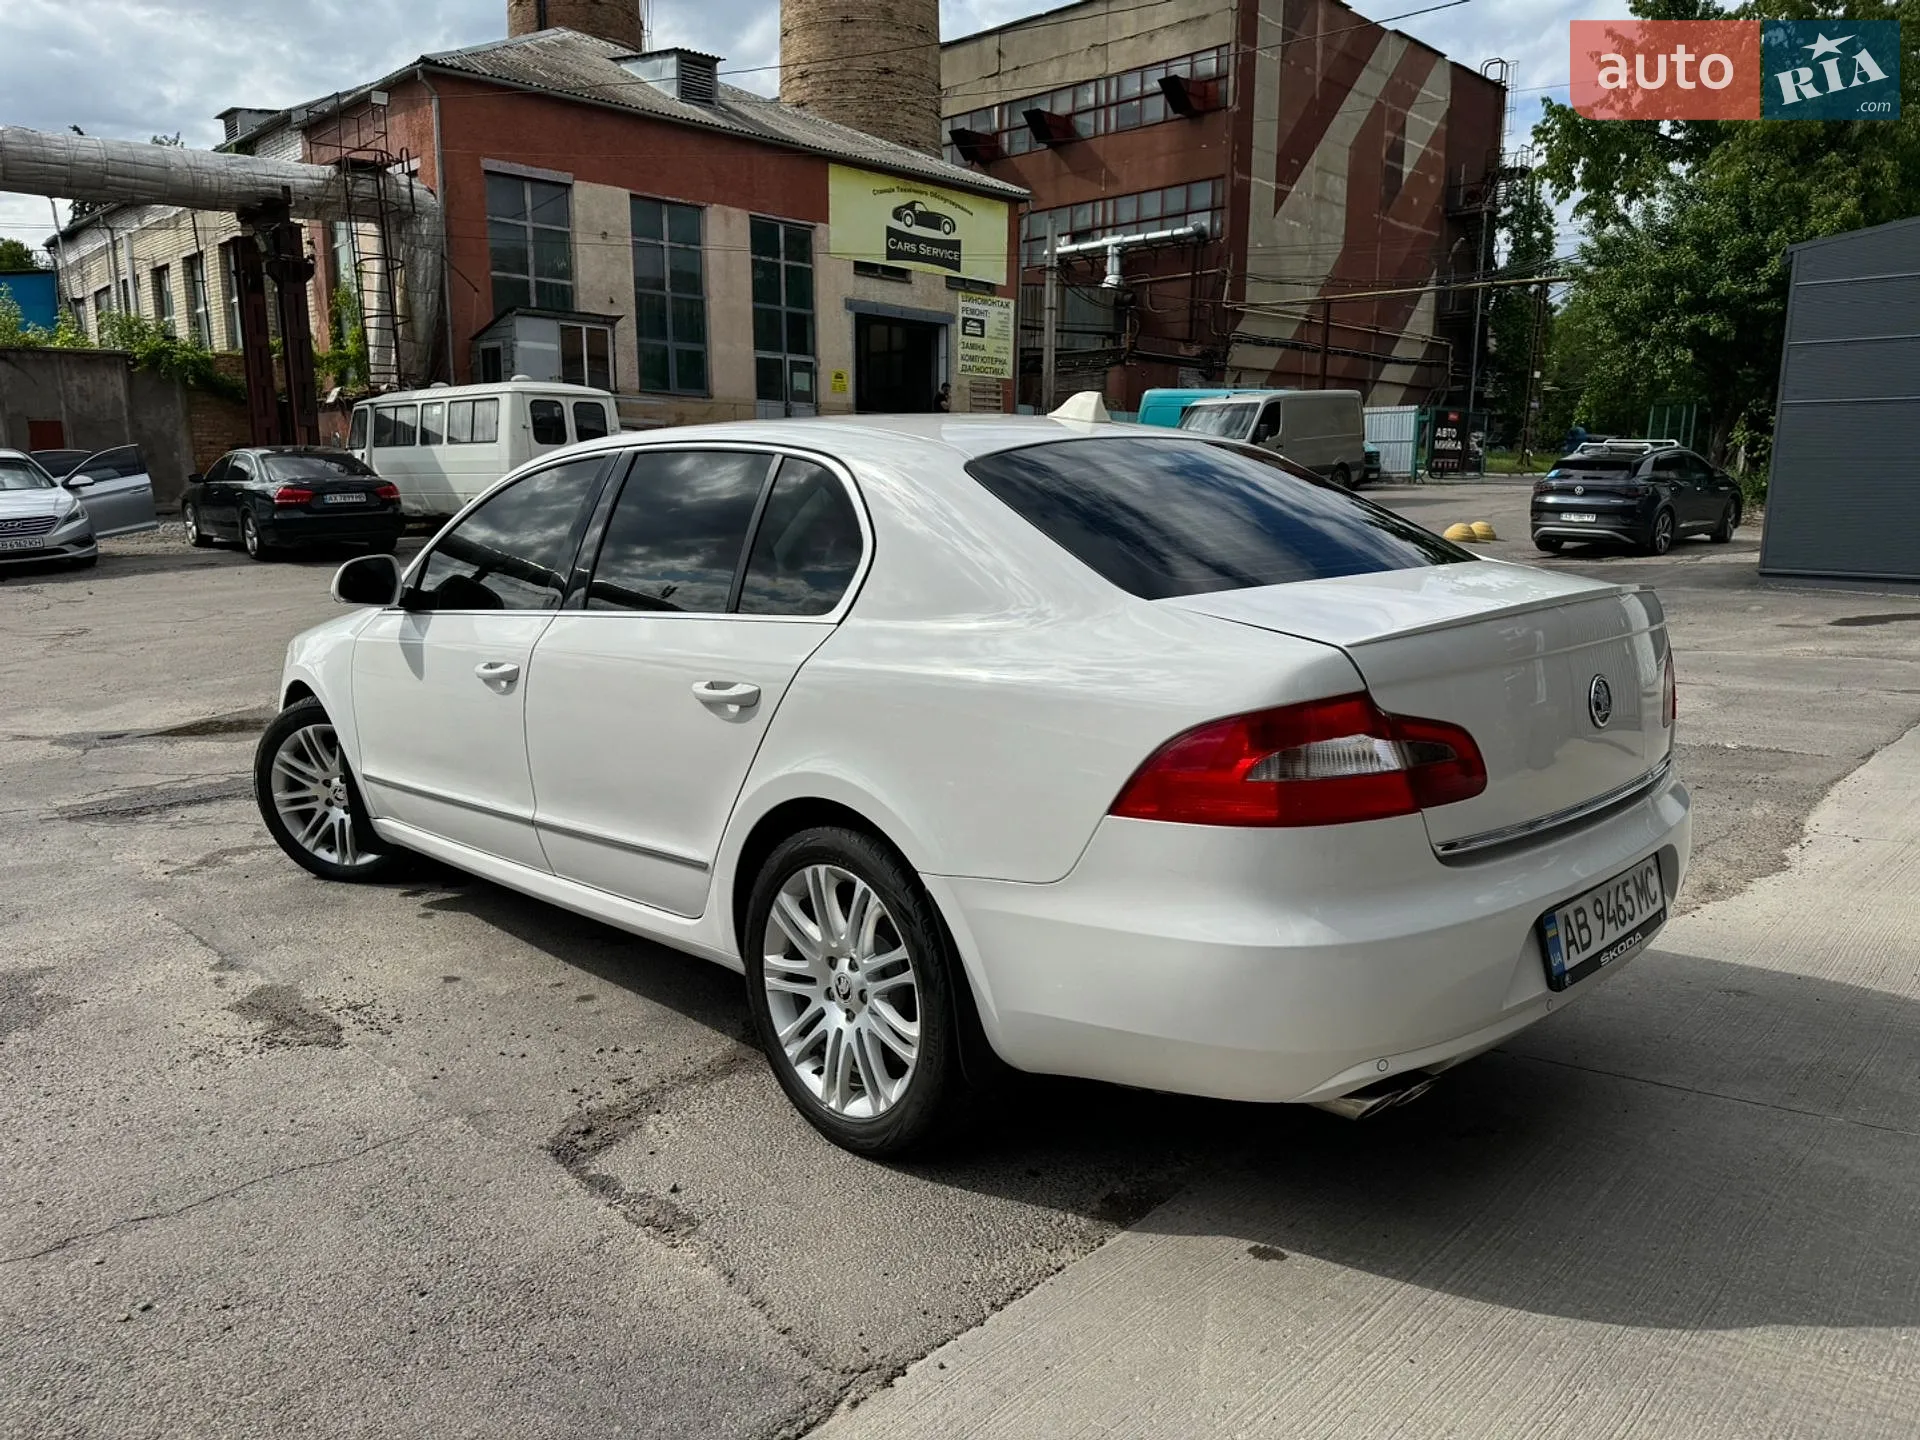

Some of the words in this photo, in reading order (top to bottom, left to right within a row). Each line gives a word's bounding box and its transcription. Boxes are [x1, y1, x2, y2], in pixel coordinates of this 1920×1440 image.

[1563, 905, 1592, 961] AB
[1593, 880, 1636, 941] 9465
[1633, 866, 1658, 915] MC
